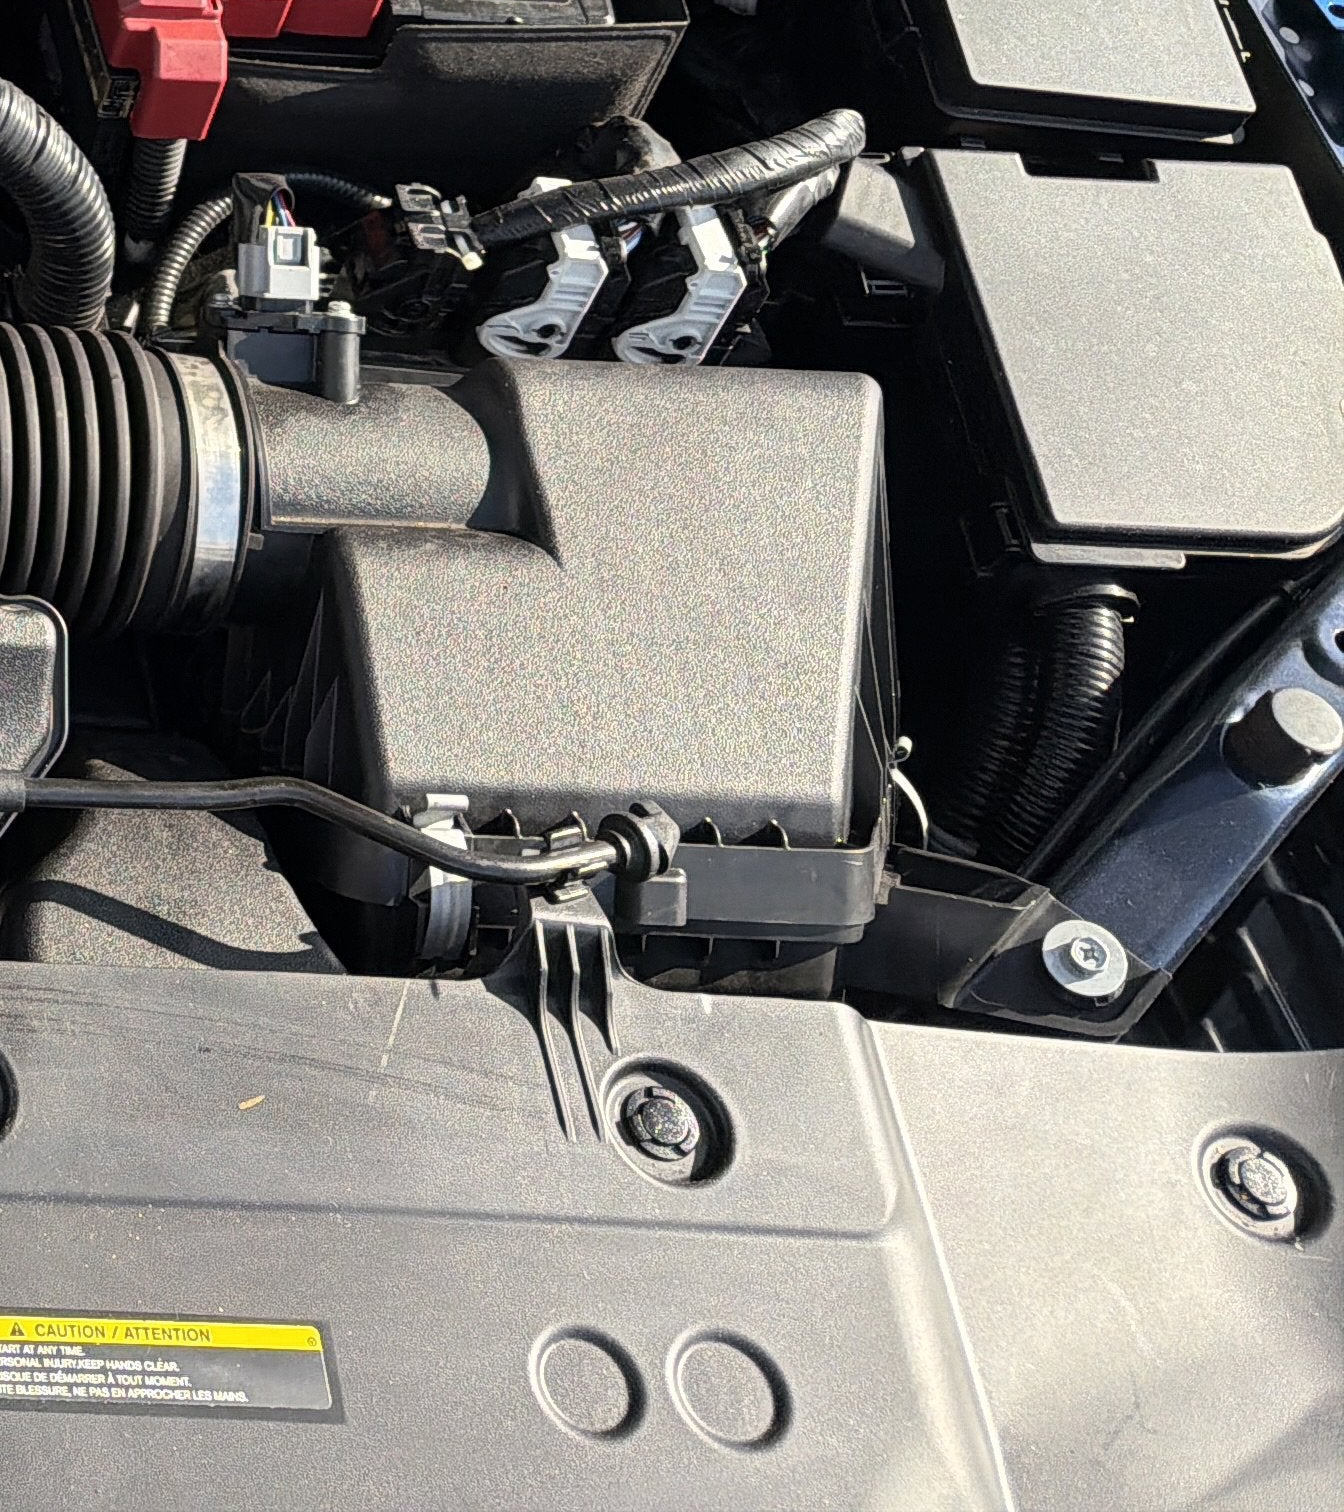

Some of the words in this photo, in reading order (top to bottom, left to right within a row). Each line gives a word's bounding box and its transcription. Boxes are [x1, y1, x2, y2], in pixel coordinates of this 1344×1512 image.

[34, 1324, 106, 1338] CAUTION
[112, 1326, 119, 1339] /
[124, 1326, 210, 1342] ATTENTION
[22, 1344, 35, 1354] AT
[37, 1345, 58, 1355] ANY
[59, 1345, 86, 1356] TIME.
[105, 1360, 142, 1371] HANDS
[33, 1371, 49, 1382] DE
[49, 1370, 106, 1384] DÉMARRER
[107, 1372, 116, 1384] À
[116, 1375, 143, 1385] TOUT
[145, 1376, 192, 1387] MOMENT.
[15, 1384, 72, 1397] BLESSURE,
[73, 1387, 88, 1397] NE
[89, 1388, 110, 1398] PAS
[111, 1388, 126, 1398] EN
[127, 1389, 191, 1400] APPROCHER
[192, 1390, 212, 1401] LES
[213, 1391, 249, 1402] MAINS.
